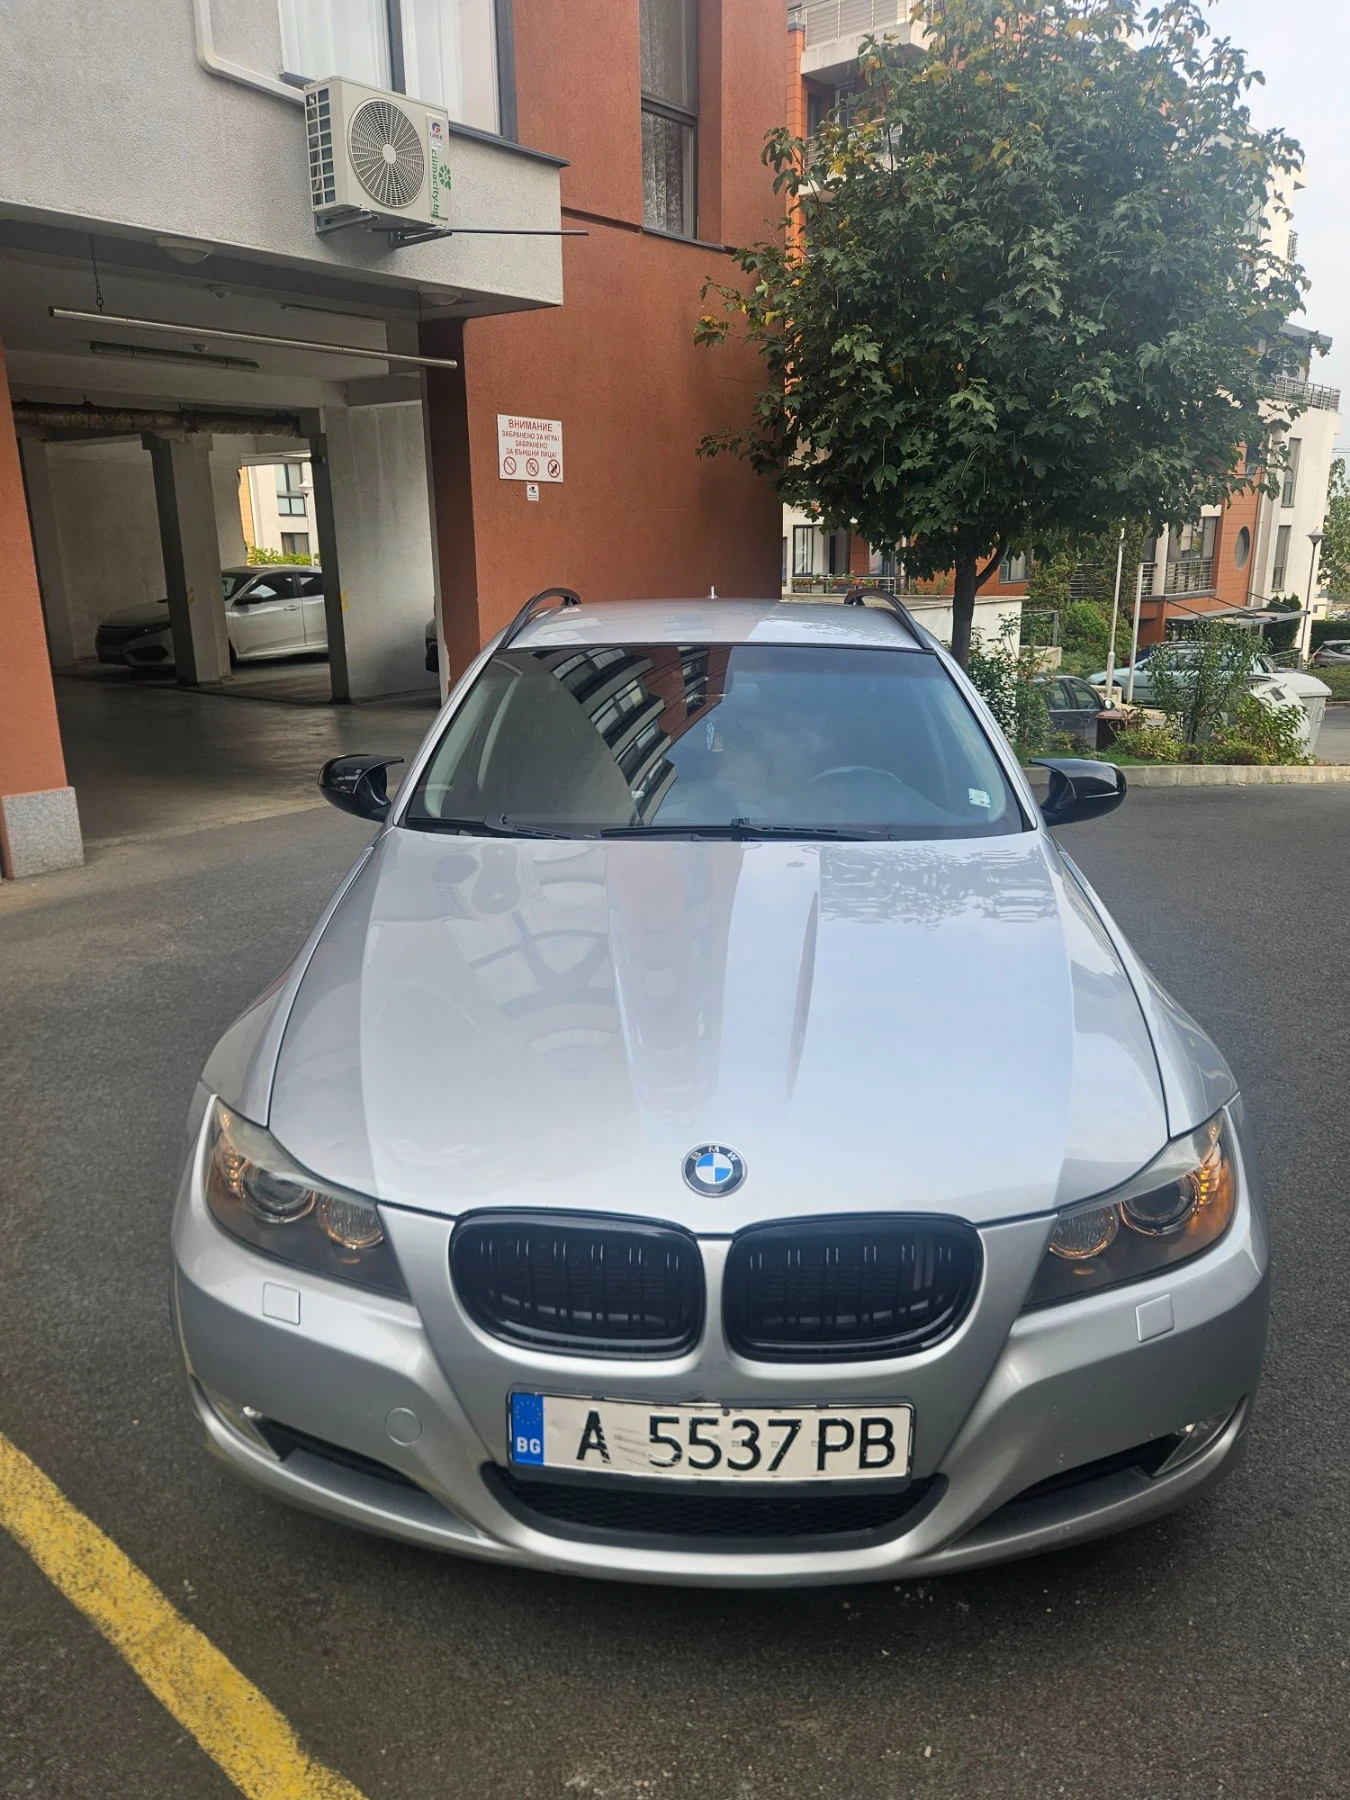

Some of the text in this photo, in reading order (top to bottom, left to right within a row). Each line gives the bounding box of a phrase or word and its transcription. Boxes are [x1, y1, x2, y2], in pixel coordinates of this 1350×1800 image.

[432, 149, 440, 217] climacity.bg
[508, 419, 553, 432] ВНИМАНИЕ
[501, 430, 535, 440] ЗАБРАНЕНО
[515, 440, 548, 449] ЗАБРАНЕНО
[690, 1145, 739, 1161] BMW
[516, 1437, 541, 1454] BG
[576, 1410, 896, 1472] A 5537 PB
